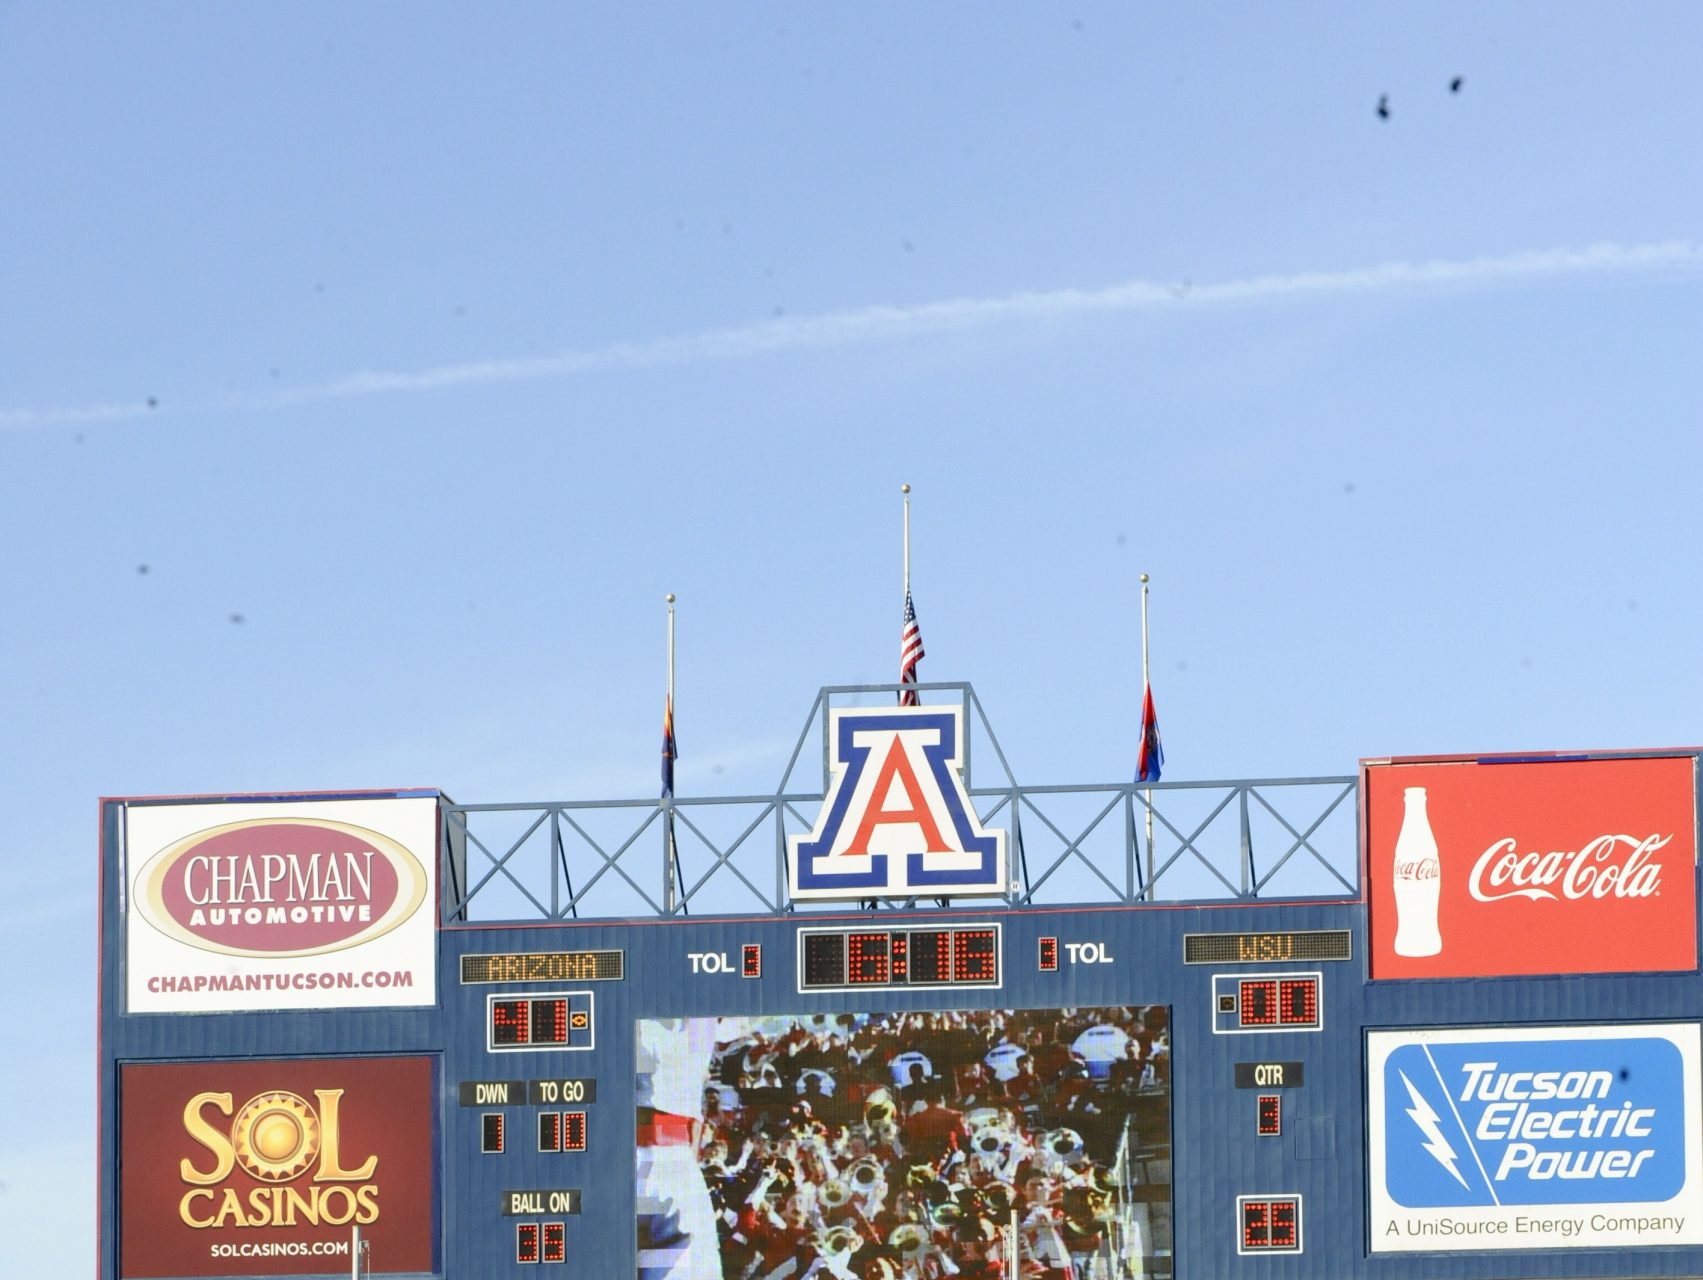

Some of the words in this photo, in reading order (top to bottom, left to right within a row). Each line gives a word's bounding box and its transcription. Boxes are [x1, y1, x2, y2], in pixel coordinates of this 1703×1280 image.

[789, 705, 1004, 898] A
[184, 851, 375, 906] CHAPMAN
[1468, 833, 1674, 903] Coca-Cola
[190, 904, 372, 927] AUTOMOTIVE
[687, 952, 736, 974] TOL
[744, 945, 760, 977] 3
[1040, 937, 1056, 970] 3
[1064, 942, 1114, 964] TOL
[1238, 935, 1293, 961] WSU
[146, 970, 413, 994] CHAPMANTUCSON.COM
[488, 953, 597, 981] ARIZONA
[540, 1081, 559, 1102] TO
[563, 1080, 585, 1102] GO
[1254, 1064, 1284, 1086] QTR
[1460, 1061, 1613, 1102] Tucson
[476, 1083, 508, 1104] DWN
[1259, 1097, 1278, 1132] 3
[1475, 1100, 1655, 1141] Electric
[179, 1088, 378, 1186] SOL
[1495, 1143, 1655, 1182] Power
[179, 1184, 380, 1229] CASINOS
[511, 1192, 545, 1214] BALL
[549, 1192, 570, 1213] ON
[1245, 1203, 1296, 1246] 25
[1385, 1219, 1401, 1237] A
[1406, 1217, 1509, 1237] UniSource
[1515, 1217, 1584, 1238] Energy
[1590, 1214, 1686, 1235] Company
[210, 1241, 349, 1258] SOLCASINOS.COM
[518, 1224, 564, 1261] 35
